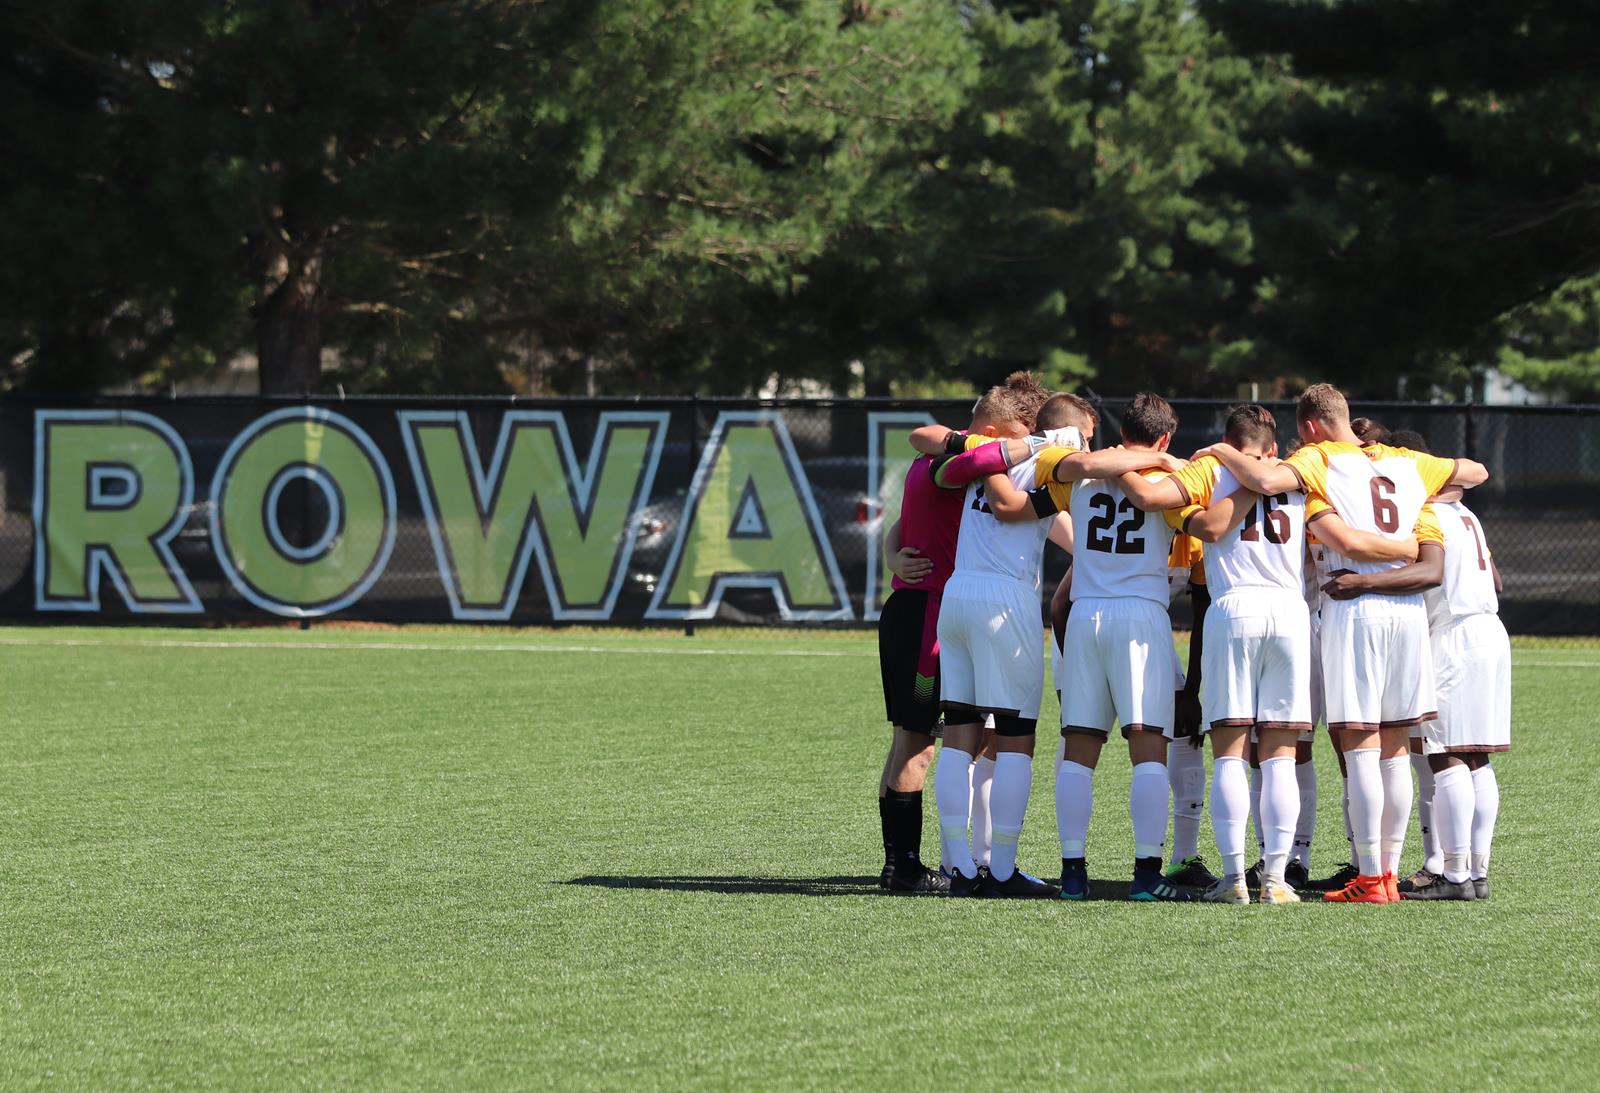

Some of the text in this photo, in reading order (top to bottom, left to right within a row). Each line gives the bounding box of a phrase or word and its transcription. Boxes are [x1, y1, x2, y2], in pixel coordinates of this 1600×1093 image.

[1086, 492, 1145, 554] 22
[1240, 491, 1292, 545] 16
[1370, 476, 1400, 534] 6
[1460, 515, 1487, 571] 7
